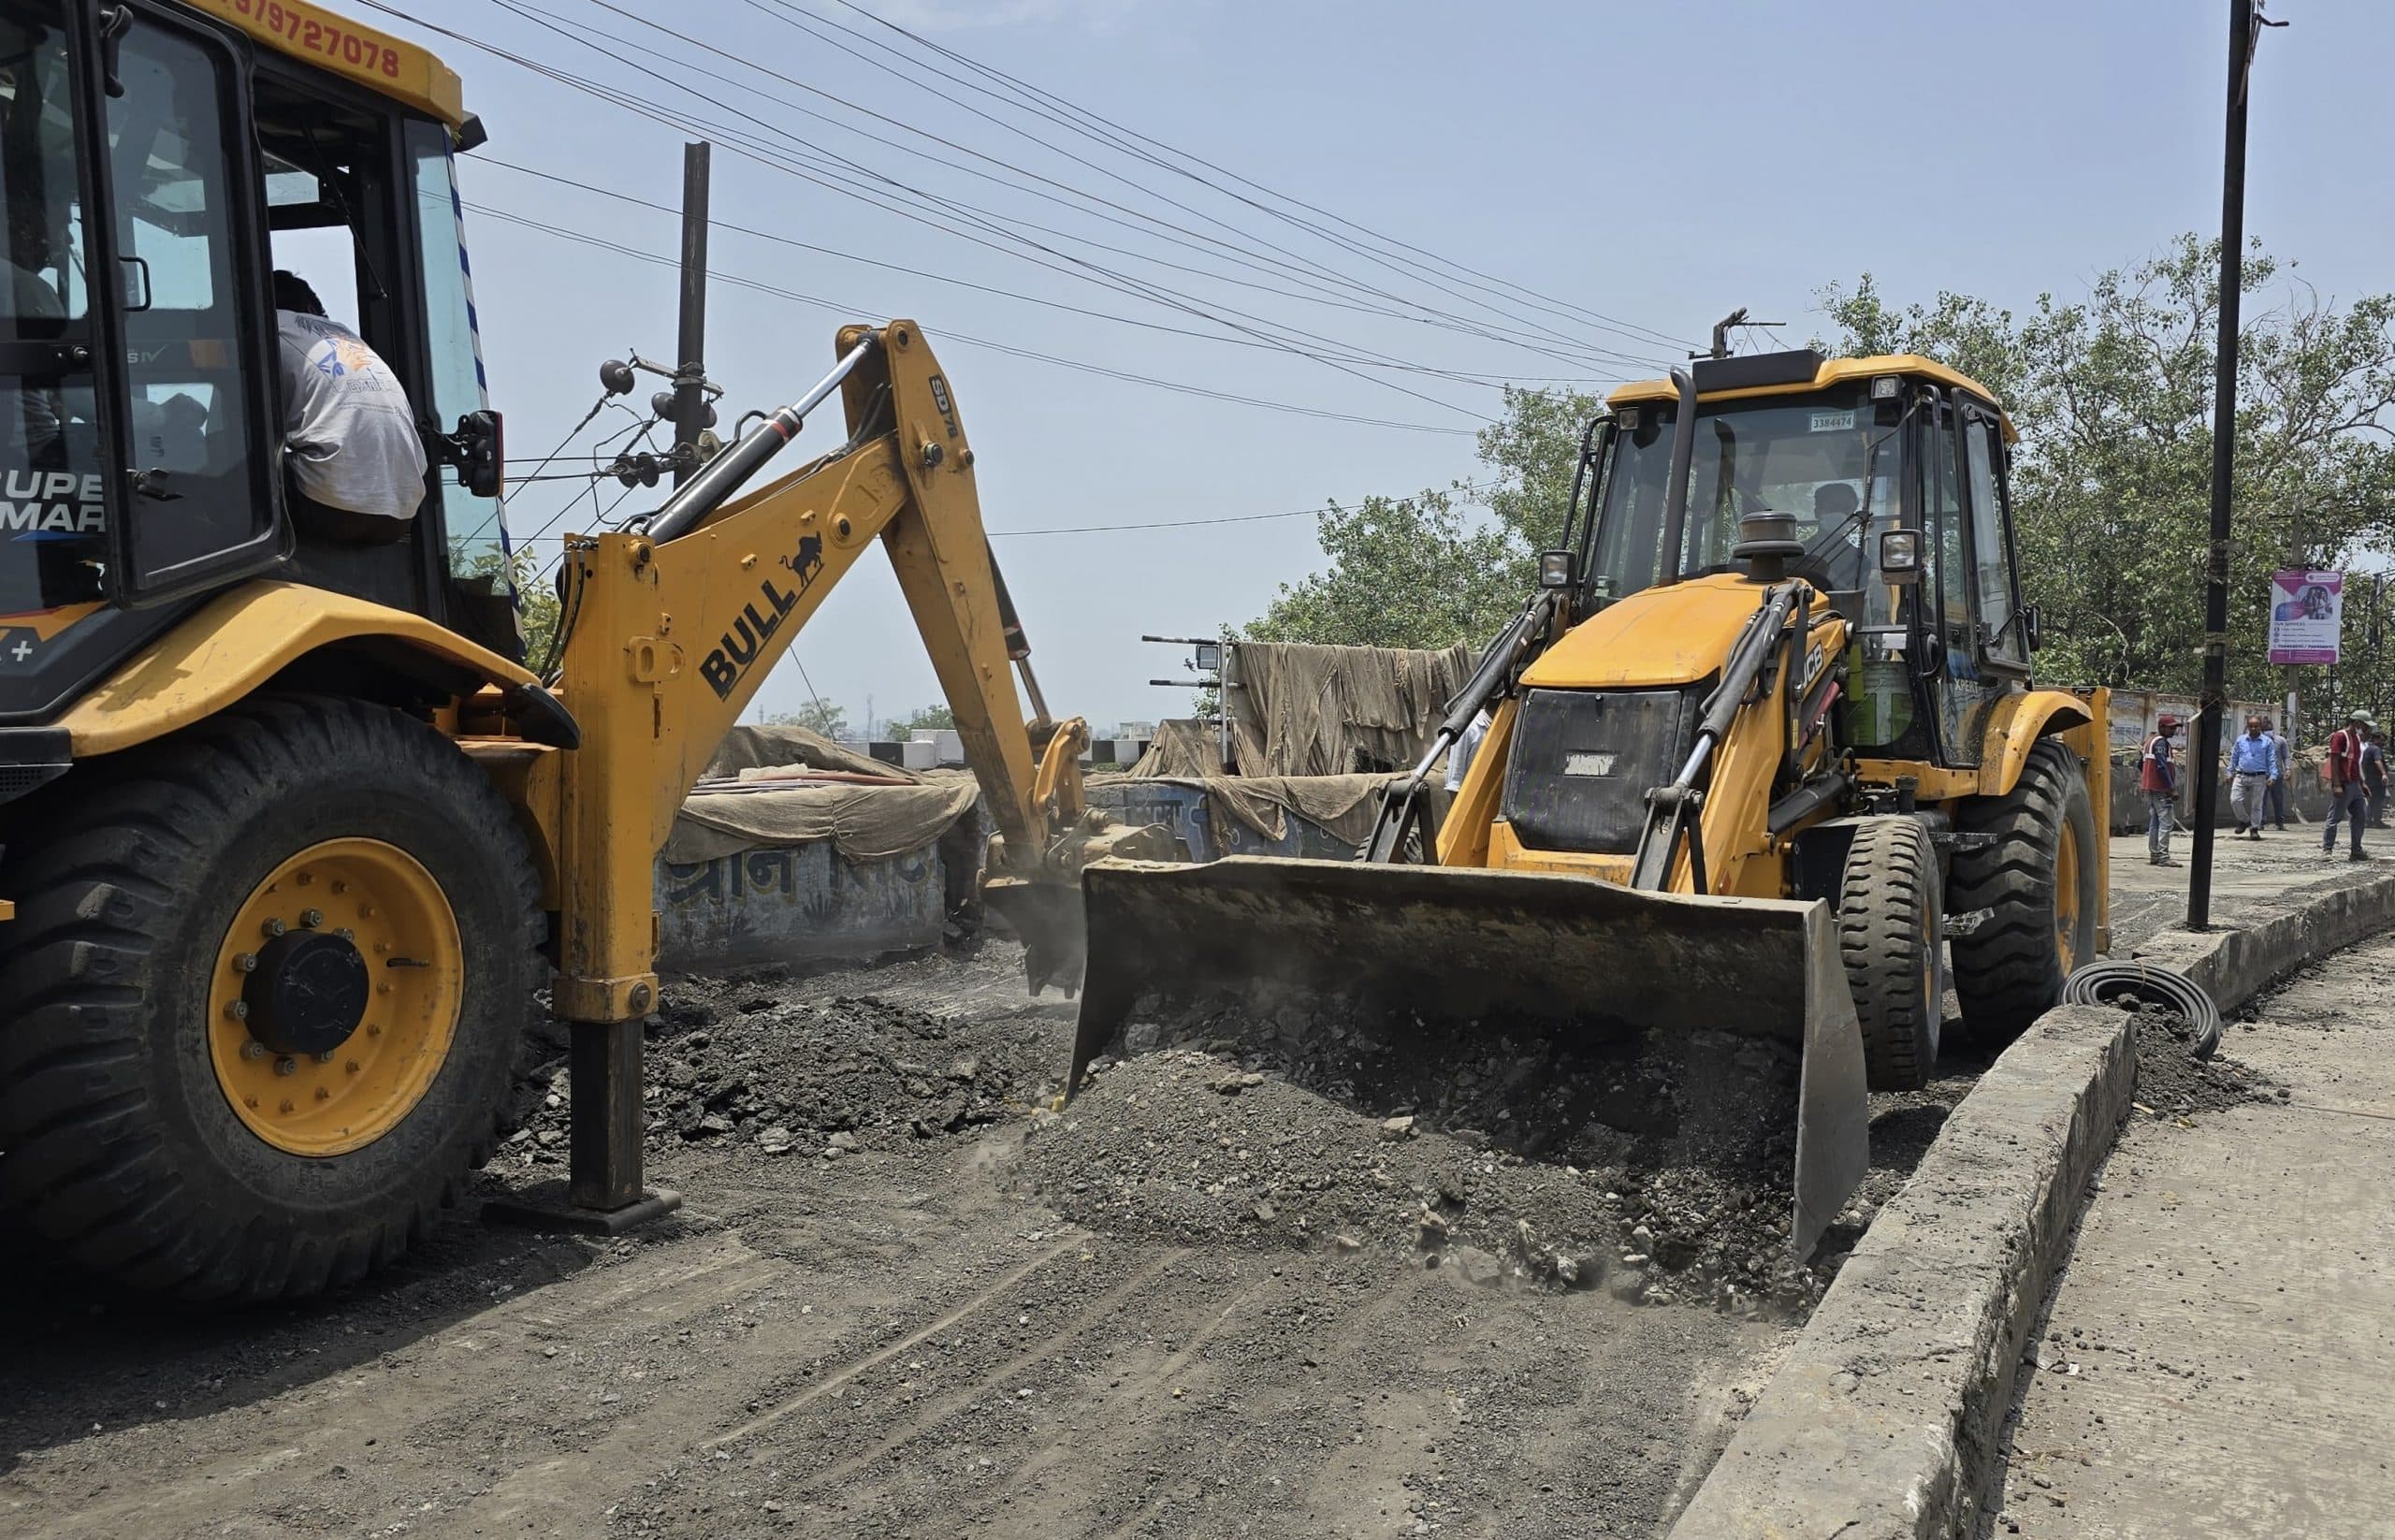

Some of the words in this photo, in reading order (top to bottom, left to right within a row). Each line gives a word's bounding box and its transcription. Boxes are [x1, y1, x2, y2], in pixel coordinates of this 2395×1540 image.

[1812, 416, 1852, 429] 3384474
[0, 469, 104, 502] UPE
[0, 500, 107, 532] MAR
[699, 578, 797, 700] BULL
